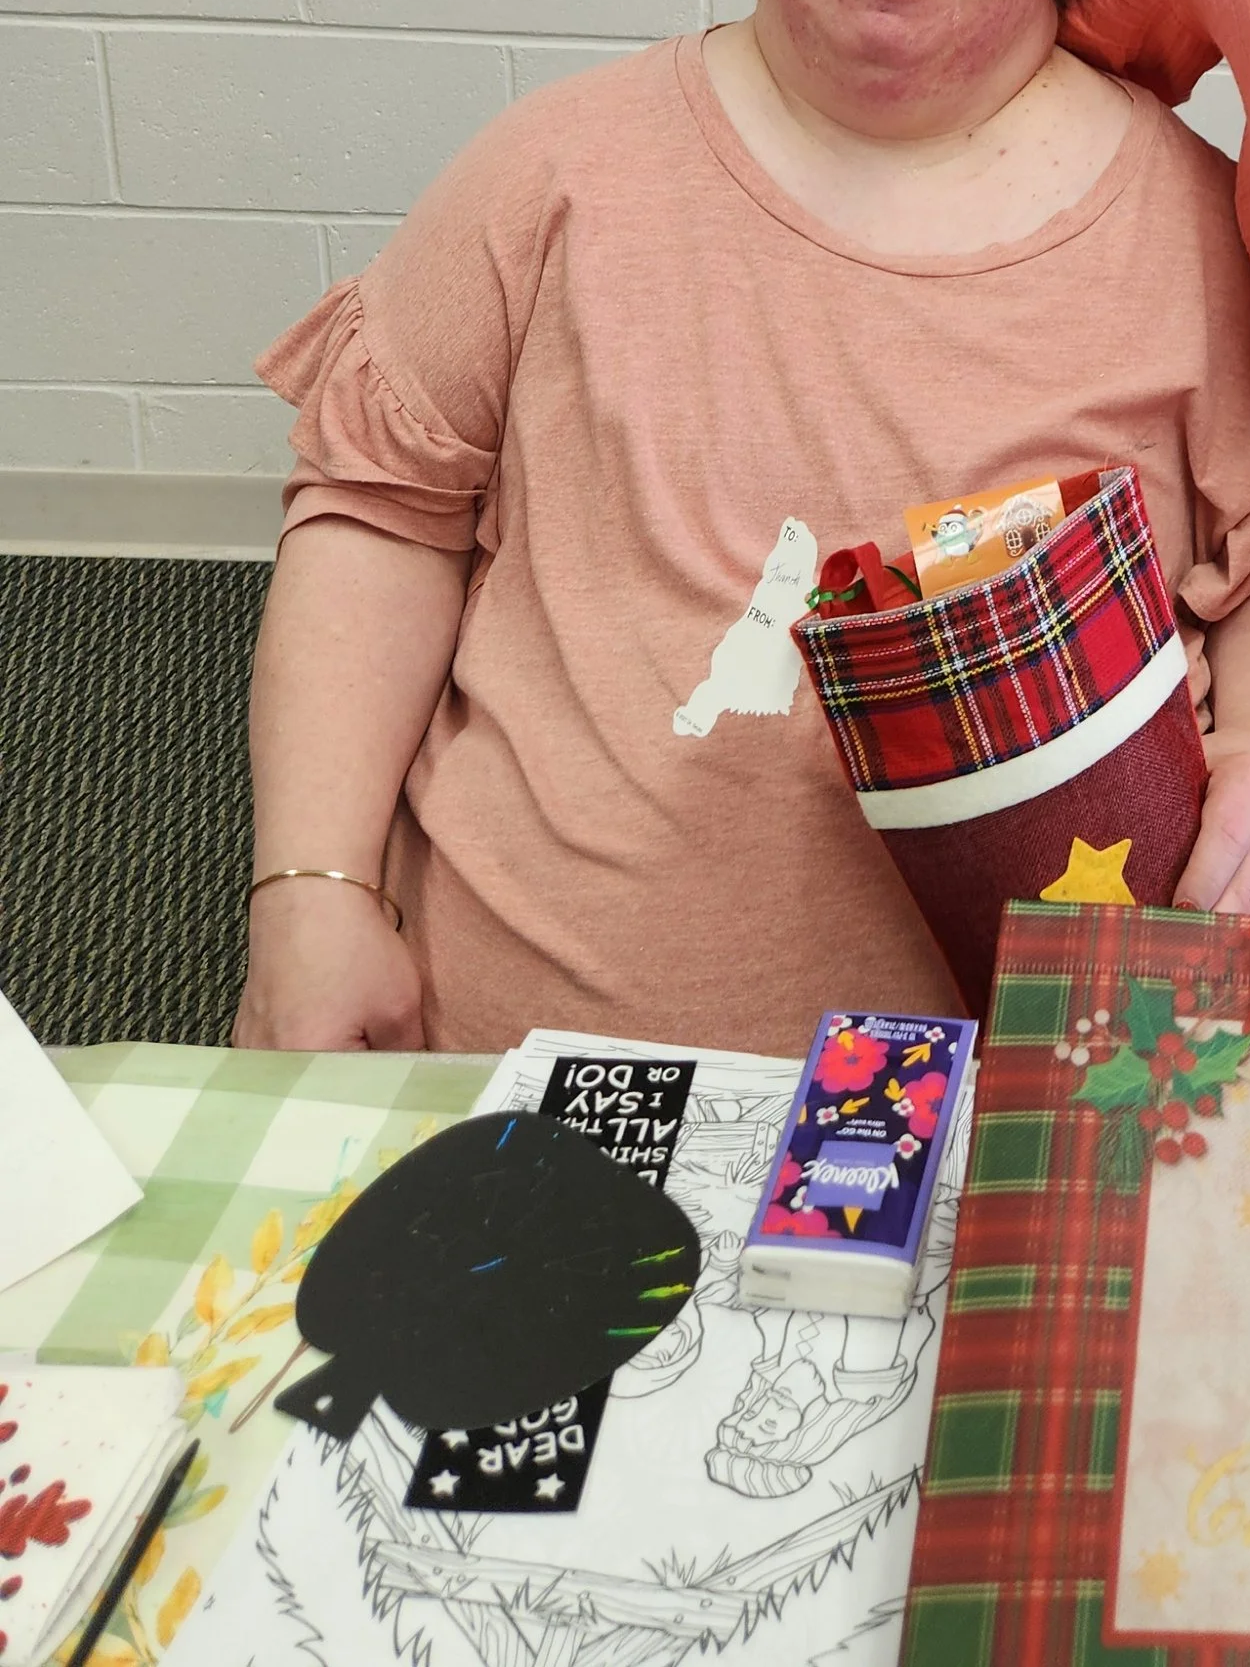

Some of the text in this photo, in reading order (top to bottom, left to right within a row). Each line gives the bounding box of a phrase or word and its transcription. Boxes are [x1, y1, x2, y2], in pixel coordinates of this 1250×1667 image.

[783, 525, 799, 543] TO:
[747, 606, 776, 630] FROM:
[563, 1063, 681, 1091] OR DO!
[564, 1089, 664, 1116] I SAY
[606, 1117, 678, 1144] ALL
[801, 1157, 900, 1195] Kleenex
[477, 1424, 585, 1474] DEAR
